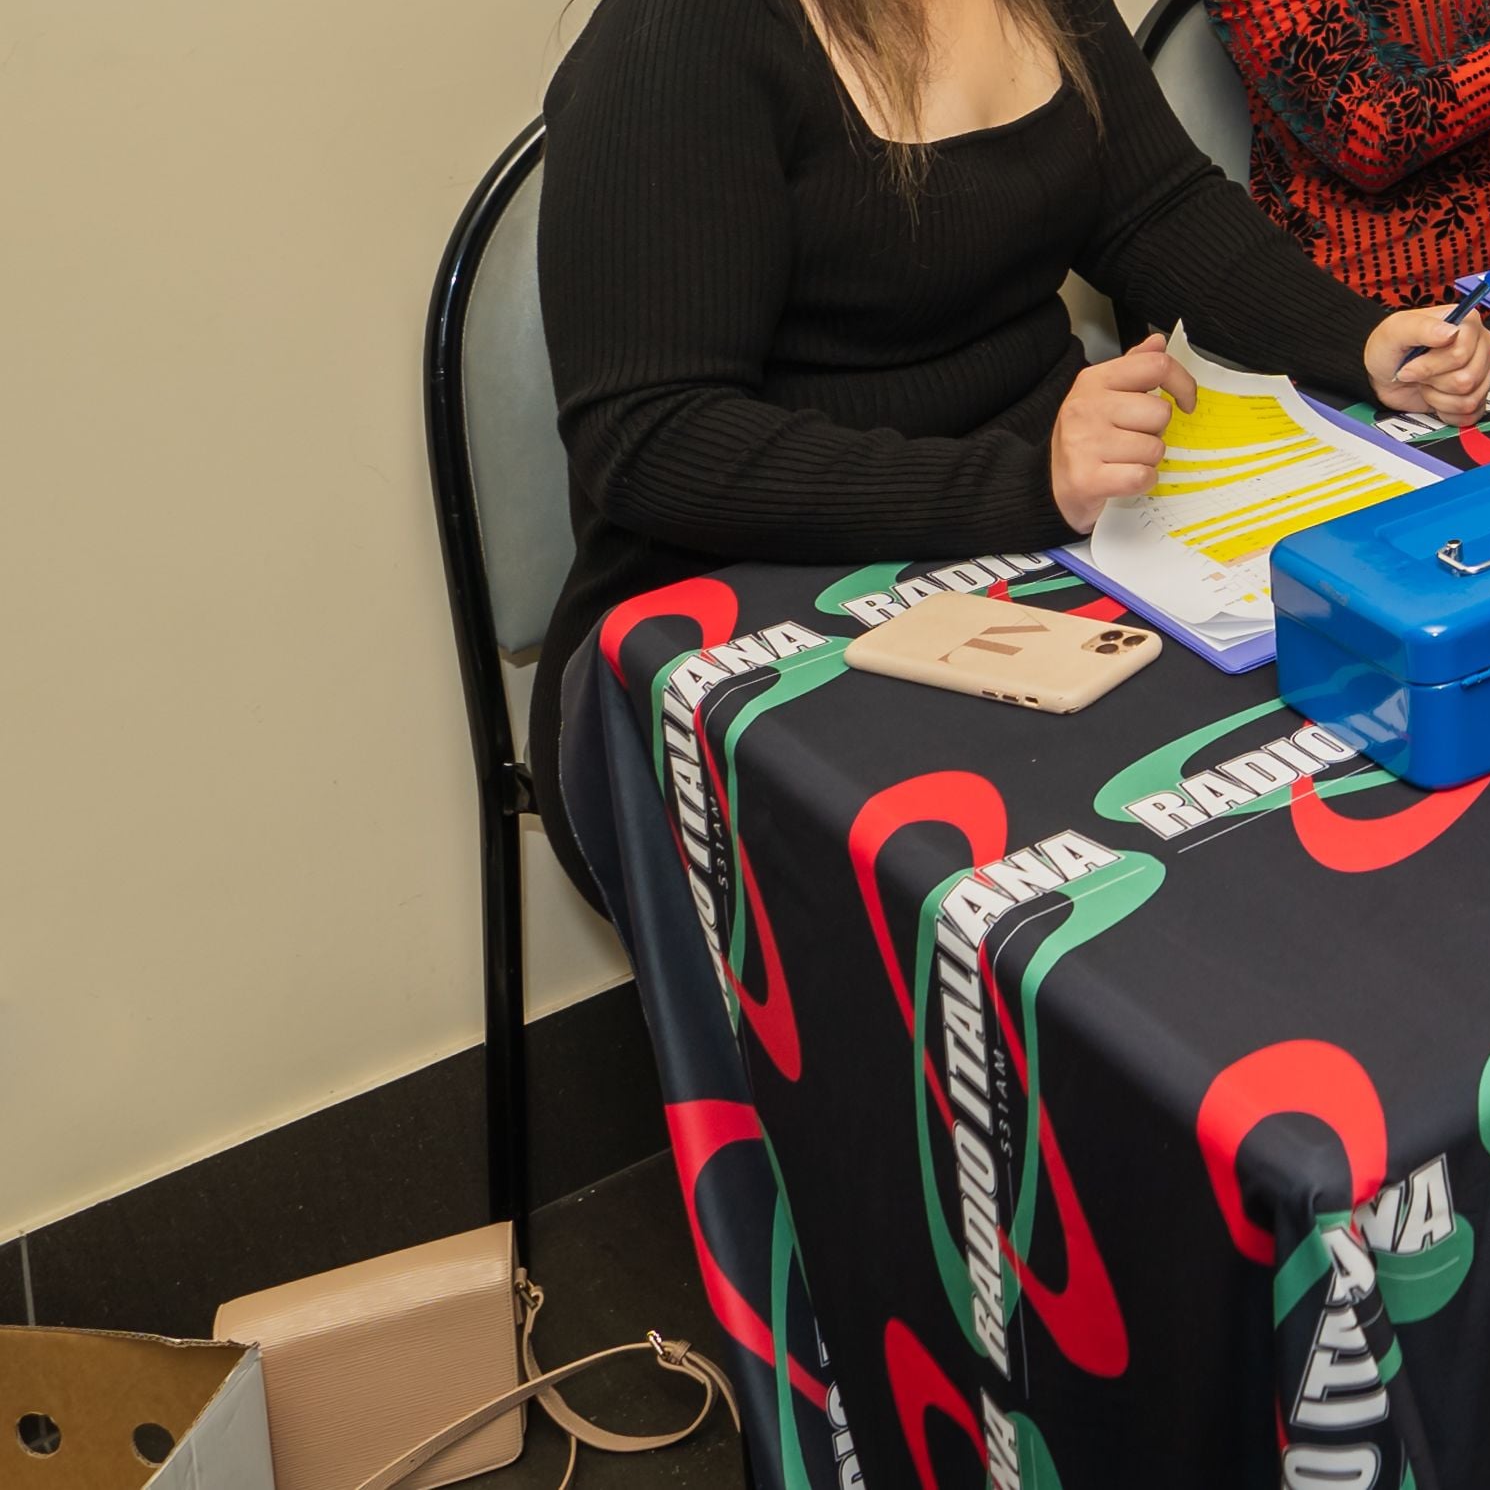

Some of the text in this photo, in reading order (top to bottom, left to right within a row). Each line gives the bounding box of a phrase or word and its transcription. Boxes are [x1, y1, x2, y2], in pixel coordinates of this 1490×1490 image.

[663, 620, 832, 874] ITALIANA
[1122, 723, 1360, 840] RADIO
[935, 829, 1126, 1382] RADIO ITALIANA
